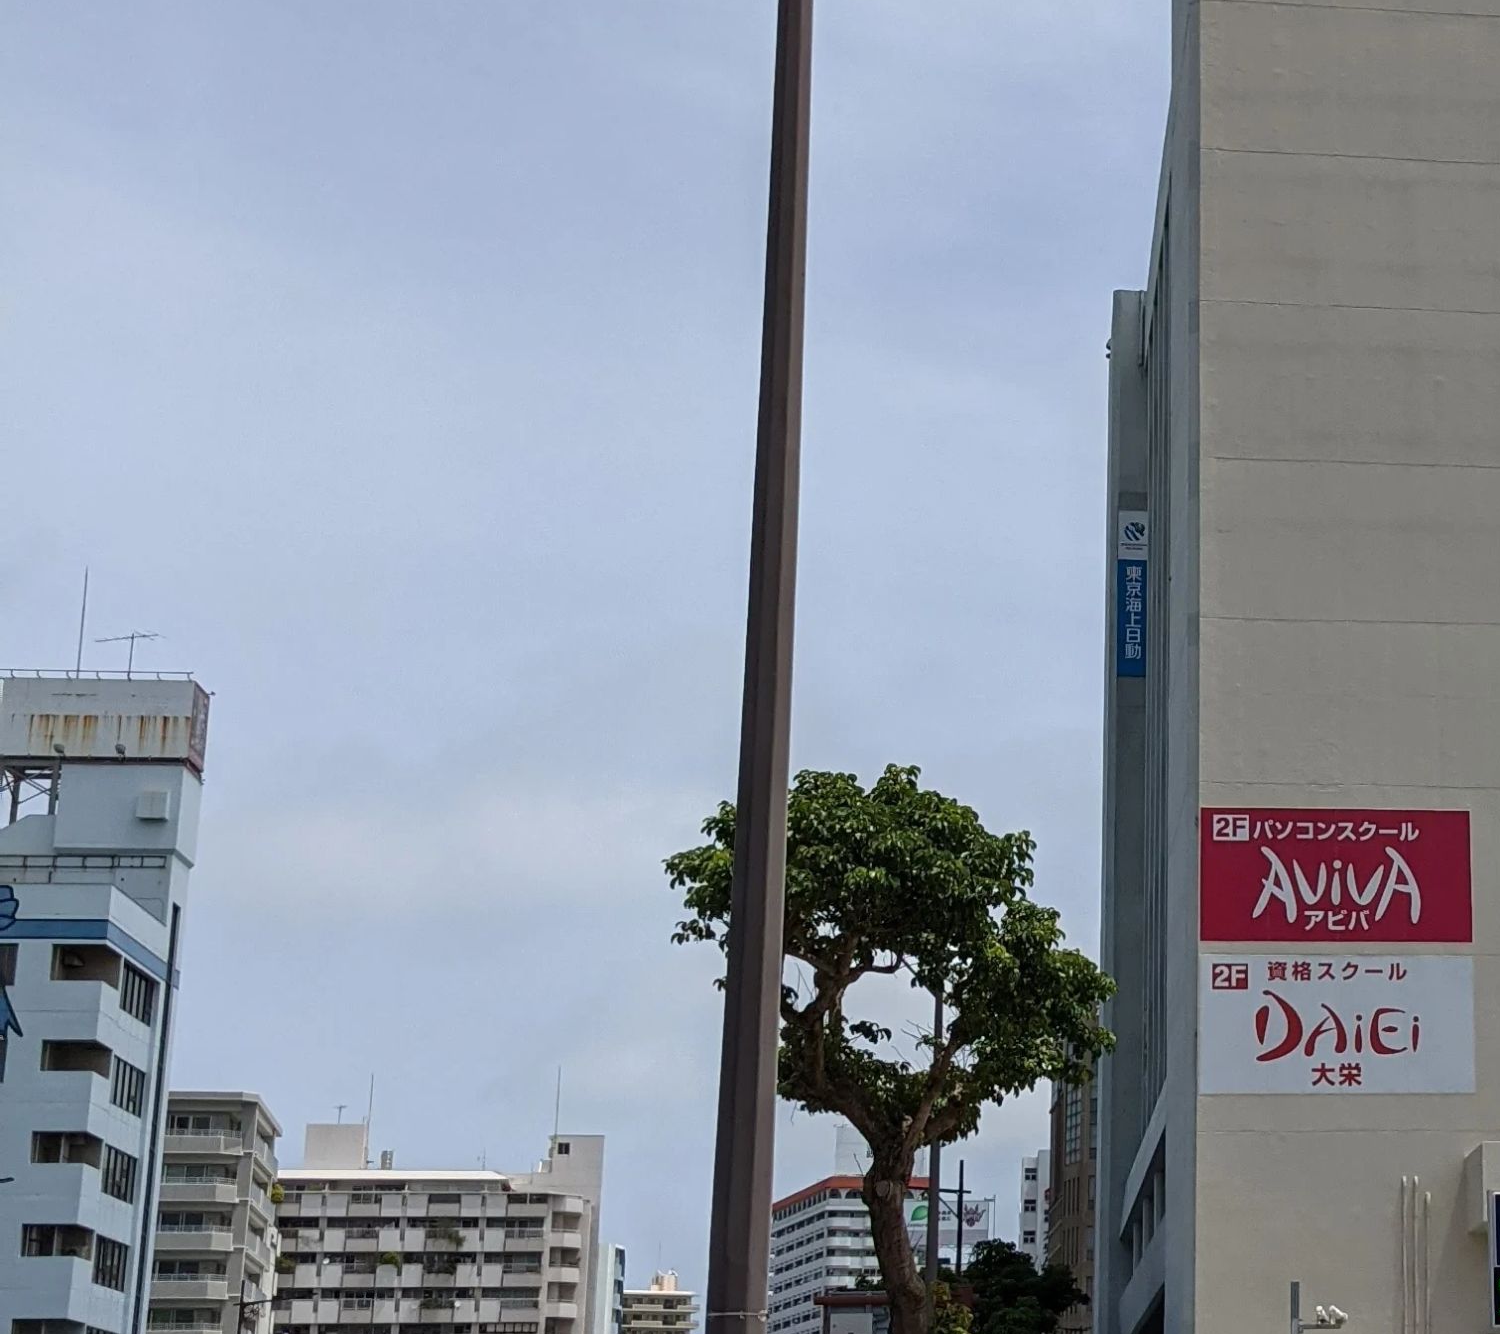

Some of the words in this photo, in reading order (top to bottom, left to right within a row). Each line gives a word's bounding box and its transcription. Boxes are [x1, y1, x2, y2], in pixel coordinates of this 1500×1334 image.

[1125, 566, 1142, 660] 東京海上日動
[1215, 817, 1248, 839] 2F
[1253, 821, 1420, 842] パソコンスクール
[1214, 966, 1247, 988] 2F
[1267, 961, 1408, 982] 資格スクール
[1311, 1062, 1363, 1087] 大栄
